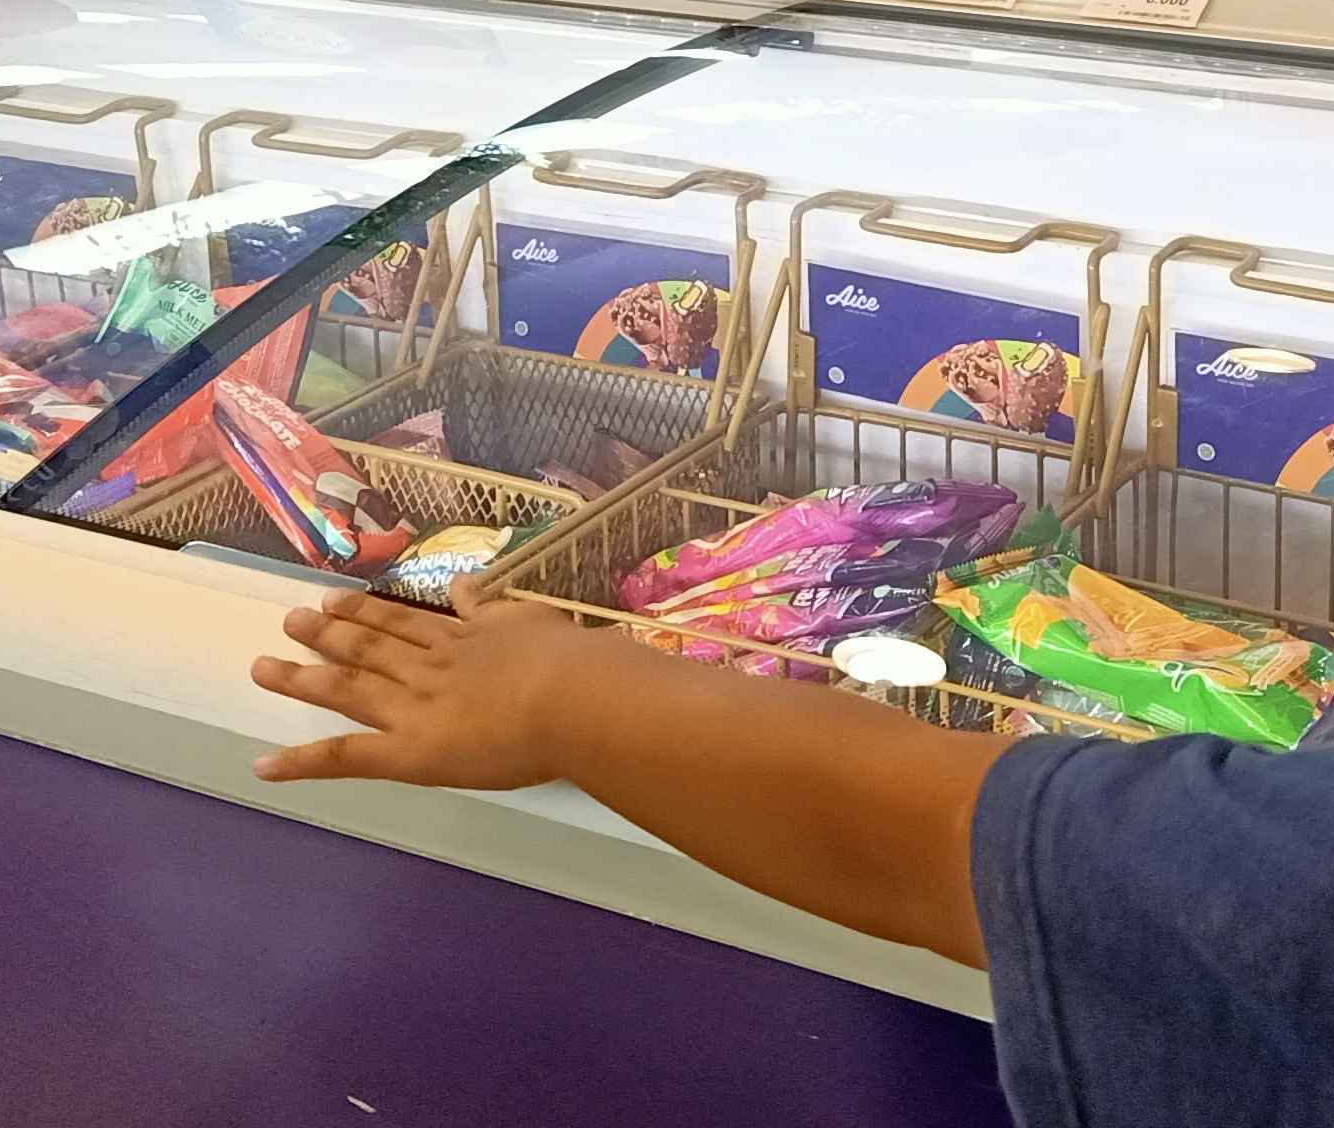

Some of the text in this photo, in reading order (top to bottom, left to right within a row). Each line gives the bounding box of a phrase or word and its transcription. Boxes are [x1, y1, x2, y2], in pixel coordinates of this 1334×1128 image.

[512, 238, 559, 263] Aice
[825, 284, 880, 312] Aice
[1196, 352, 1259, 381] Aice
